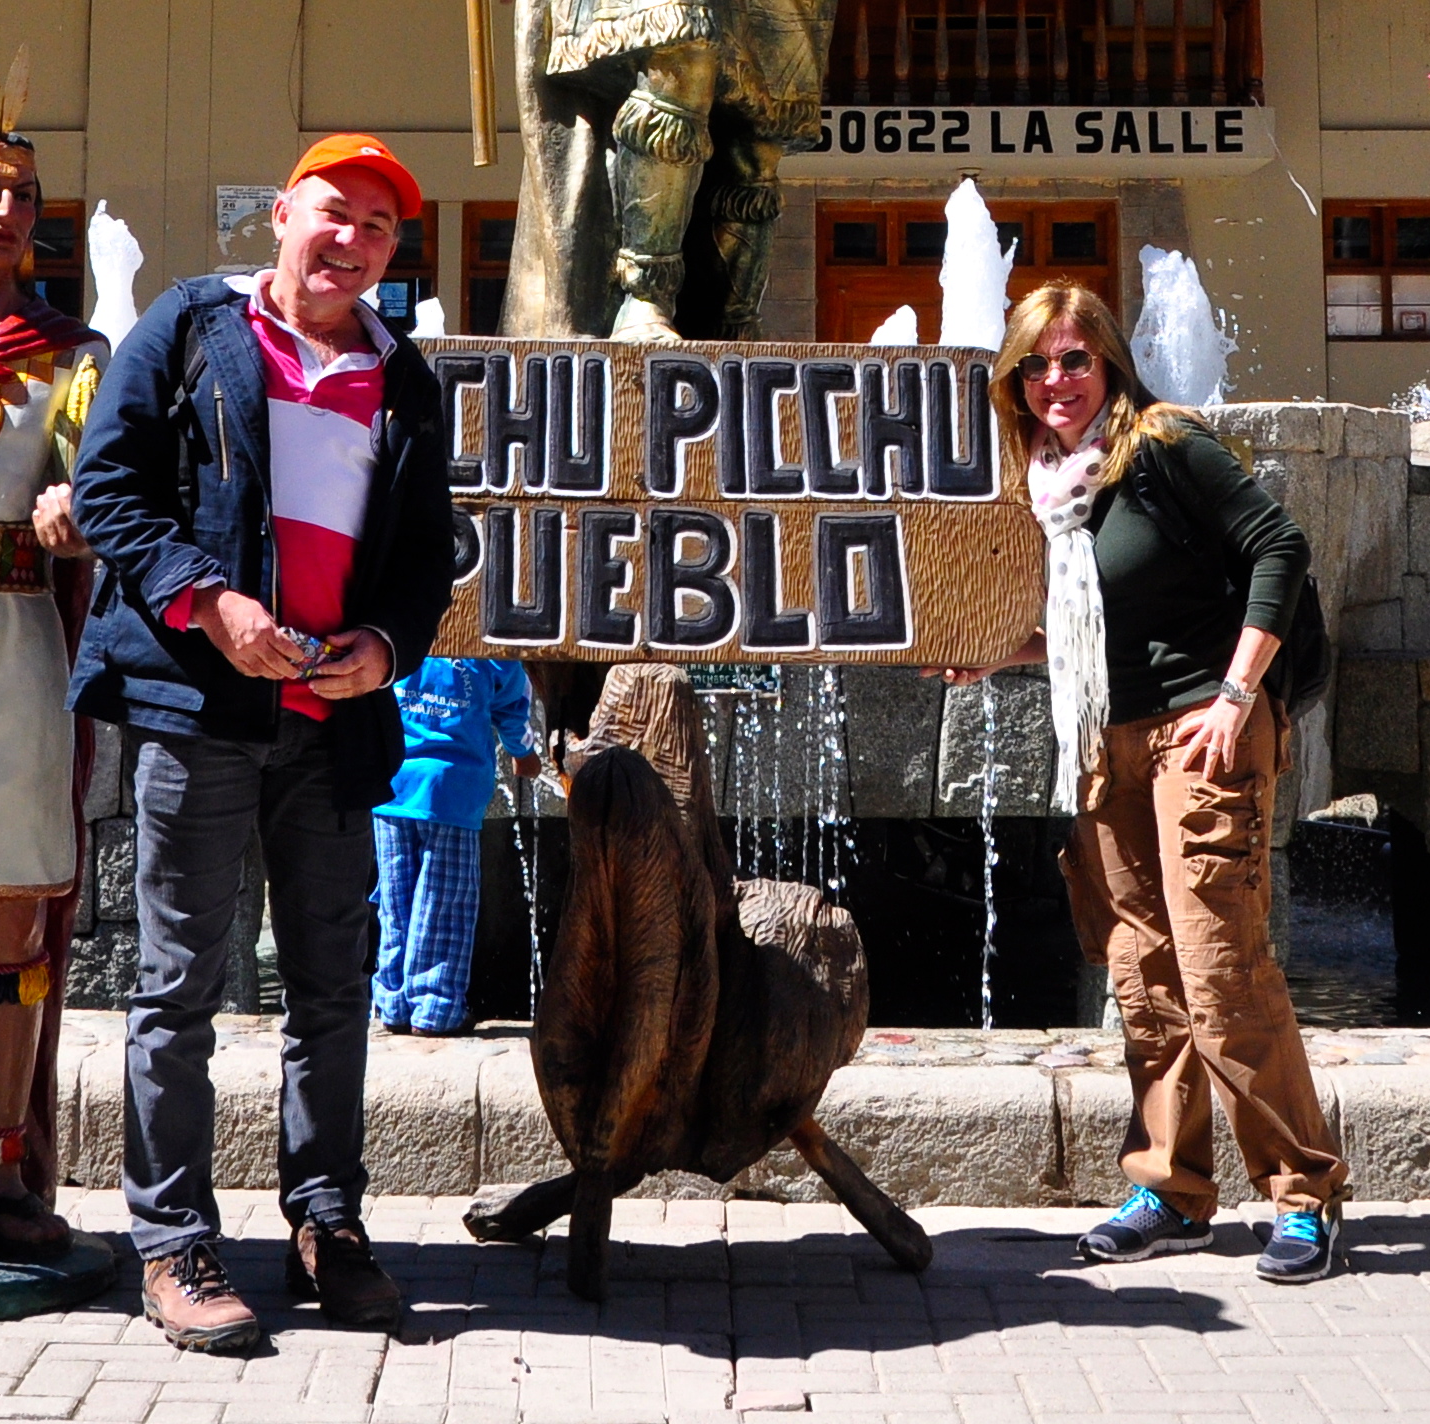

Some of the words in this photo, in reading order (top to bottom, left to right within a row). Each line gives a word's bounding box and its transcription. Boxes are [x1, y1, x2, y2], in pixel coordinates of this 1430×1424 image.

[990, 110, 1054, 154] LA
[1074, 110, 1244, 154] SALLE
[429, 349, 613, 497] CHU
[644, 351, 1001, 501] PICCHU
